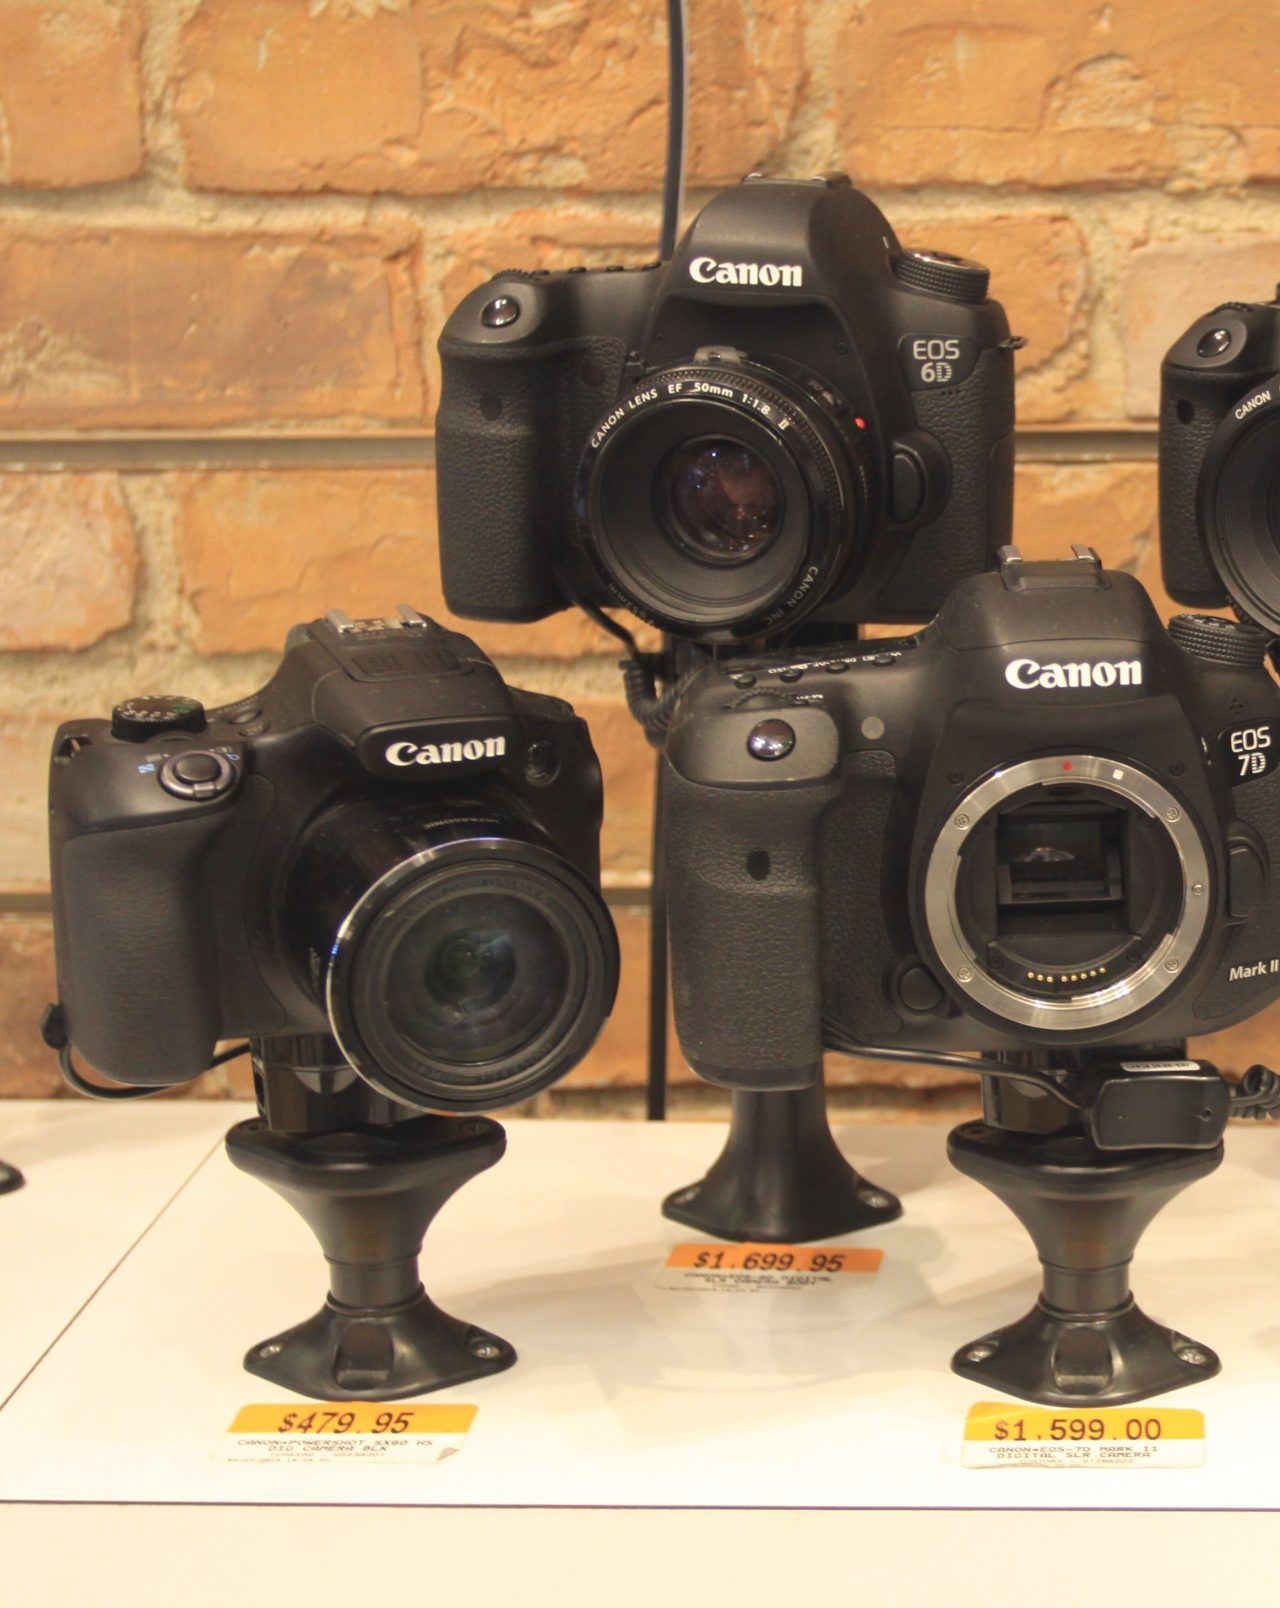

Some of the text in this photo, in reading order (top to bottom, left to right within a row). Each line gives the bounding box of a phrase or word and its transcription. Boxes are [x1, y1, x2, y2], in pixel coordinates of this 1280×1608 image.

[689, 257, 803, 287] Canon
[912, 339, 960, 360] EOS
[920, 362, 952, 383] 6D
[591, 407, 625, 449] CANON
[628, 388, 659, 409] LENS
[667, 382, 683, 395] EF
[694, 382, 734, 398] 50mm
[741, 393, 772, 416] 1:1.8
[1234, 390, 1272, 421] CANON
[787, 565, 819, 608] CANON
[1004, 658, 1143, 690] Canon
[385, 735, 506, 767] Canon
[1230, 726, 1272, 753] EOS
[1237, 752, 1267, 777] 7D
[1229, 959, 1280, 982] Mark II
[277, 1411, 416, 1434] $479.95
